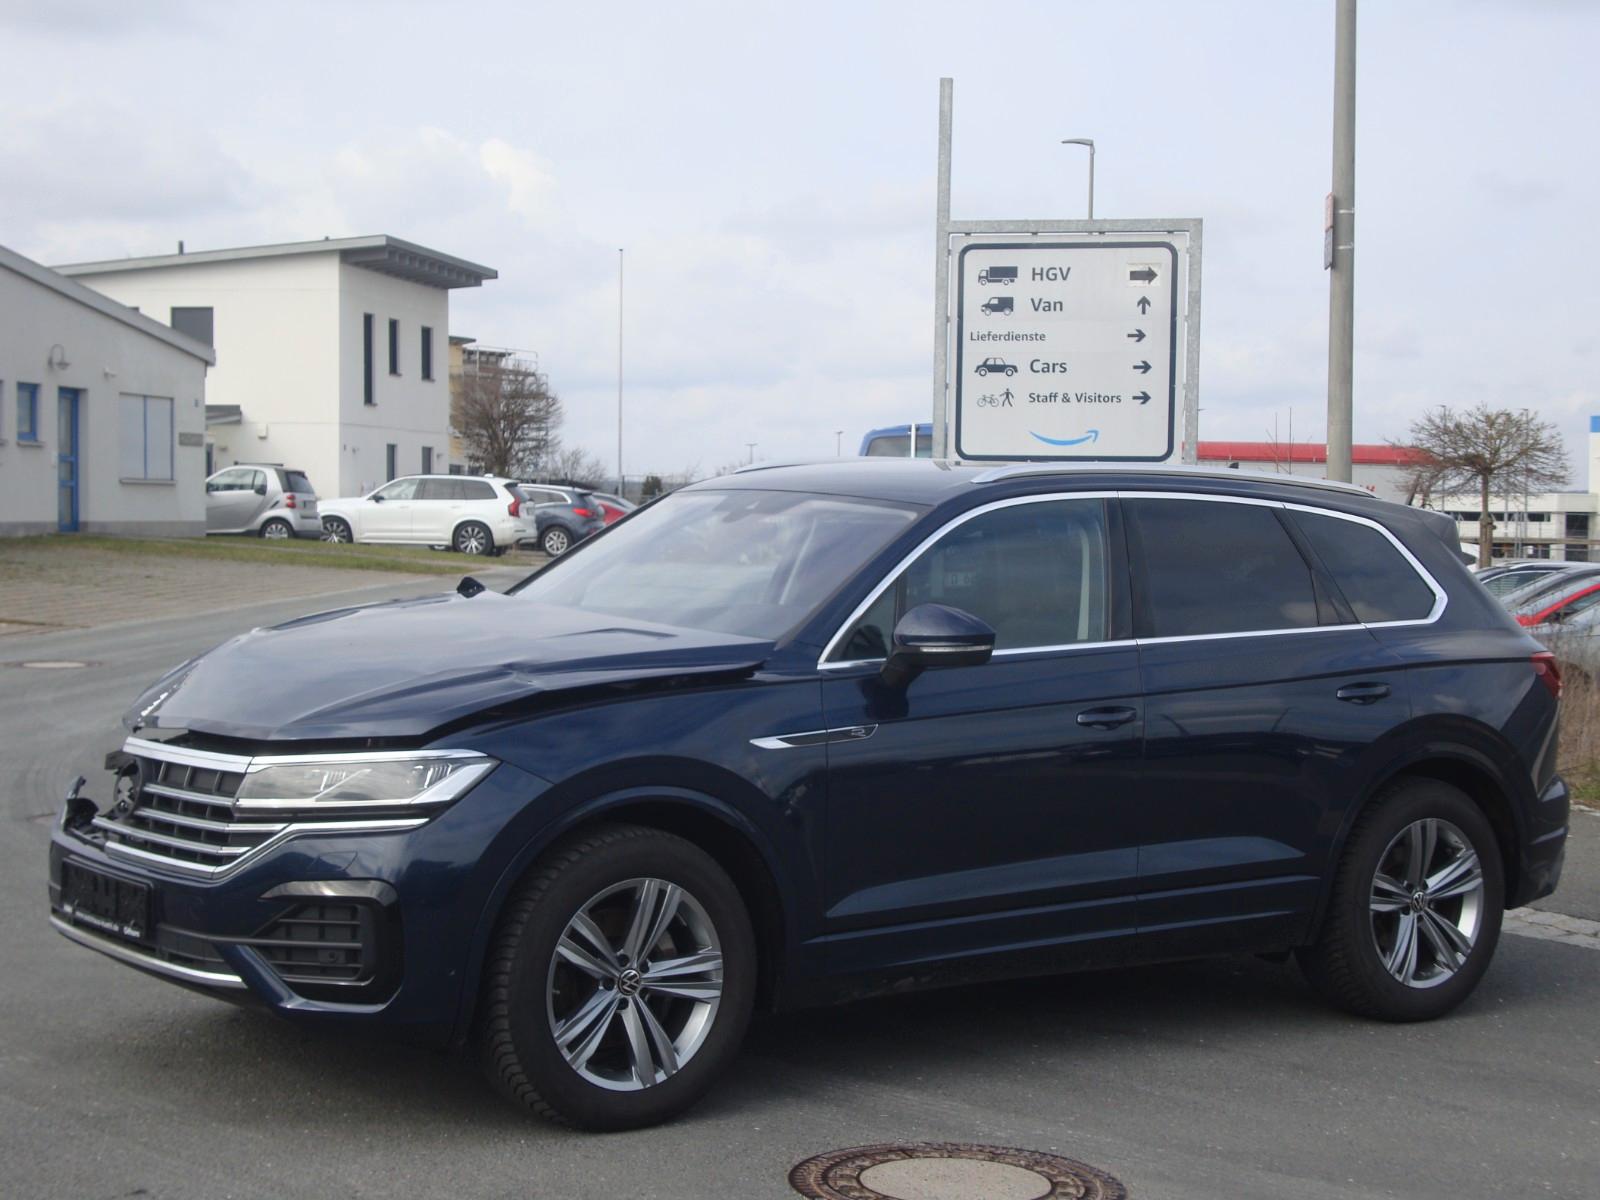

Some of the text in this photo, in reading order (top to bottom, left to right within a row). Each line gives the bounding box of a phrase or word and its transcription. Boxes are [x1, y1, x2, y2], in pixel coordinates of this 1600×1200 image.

[1031, 267, 1071, 282] HGV
[1030, 298, 1064, 312] Van
[970, 331, 1046, 342] Lieferdienste
[1030, 359, 1067, 373] Cars
[1028, 392, 1122, 403] Staff & Visitors
